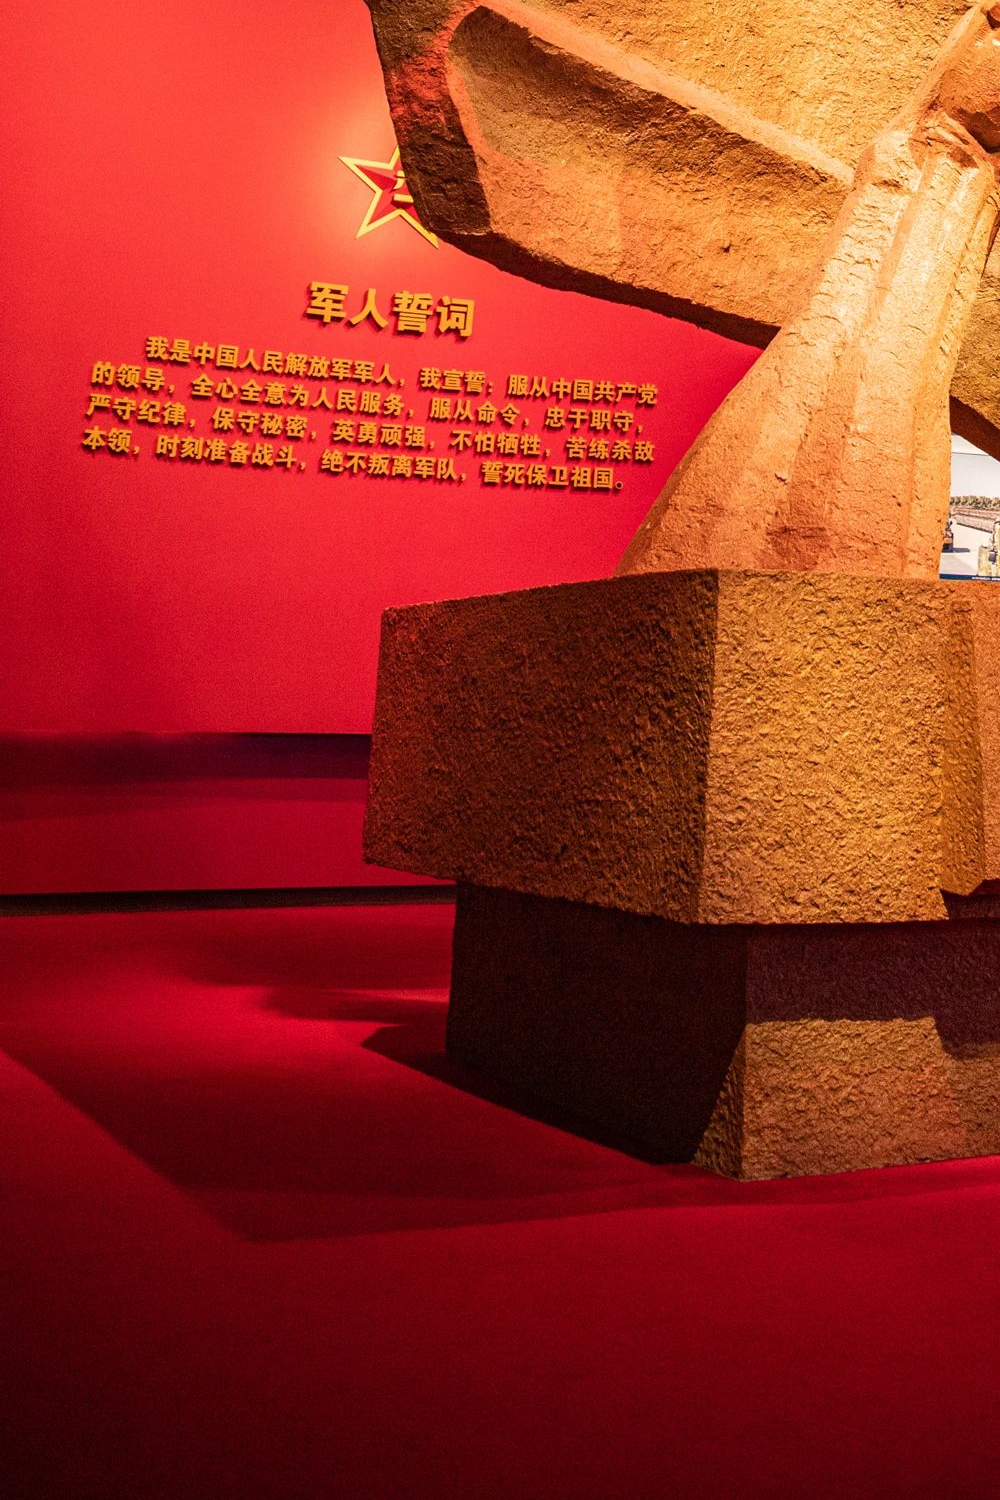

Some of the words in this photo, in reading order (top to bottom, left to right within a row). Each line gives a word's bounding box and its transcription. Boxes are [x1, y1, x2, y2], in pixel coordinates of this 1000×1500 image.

[306, 281, 475, 338] 军人誓词
[91, 361, 644, 433] 的领导，全心全意为人民服务，服从命令，忠于职守，
[146, 335, 658, 405] 我是中国人民解放军军人，我宣誓：服从中国共产党
[82, 425, 624, 490] 本领，时刻准备战斗，绝不叛离军队，誓死保卫祖国。
[86, 393, 656, 462] 严守纪律，保守秘密，英勇顽强，不怕牺牲，苦练杀敌
